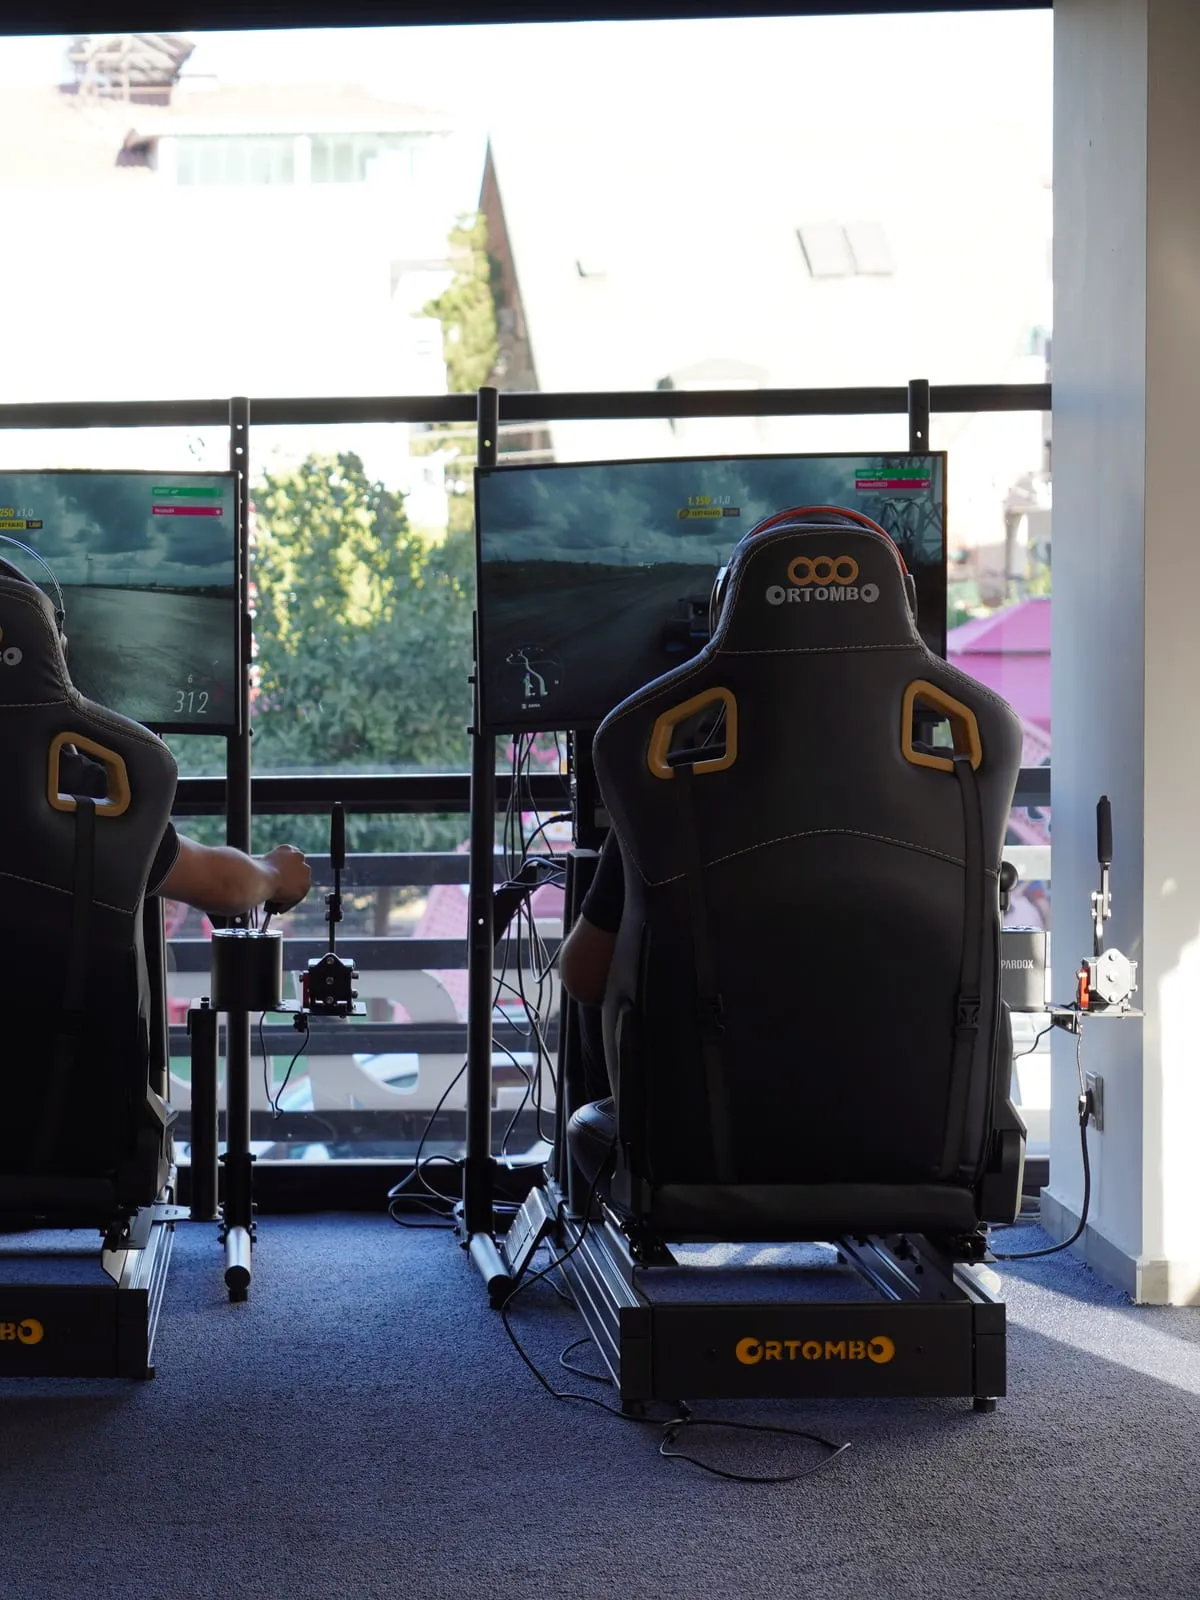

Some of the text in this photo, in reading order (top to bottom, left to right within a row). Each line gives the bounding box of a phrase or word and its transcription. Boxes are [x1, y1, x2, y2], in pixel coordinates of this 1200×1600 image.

[765, 583, 880, 606] ORTOMBO
[187, 673, 193, 684] 6
[173, 690, 209, 714] 312
[1000, 959, 1034, 969] PARDOX
[735, 1335, 896, 1365] ORTOMBO
